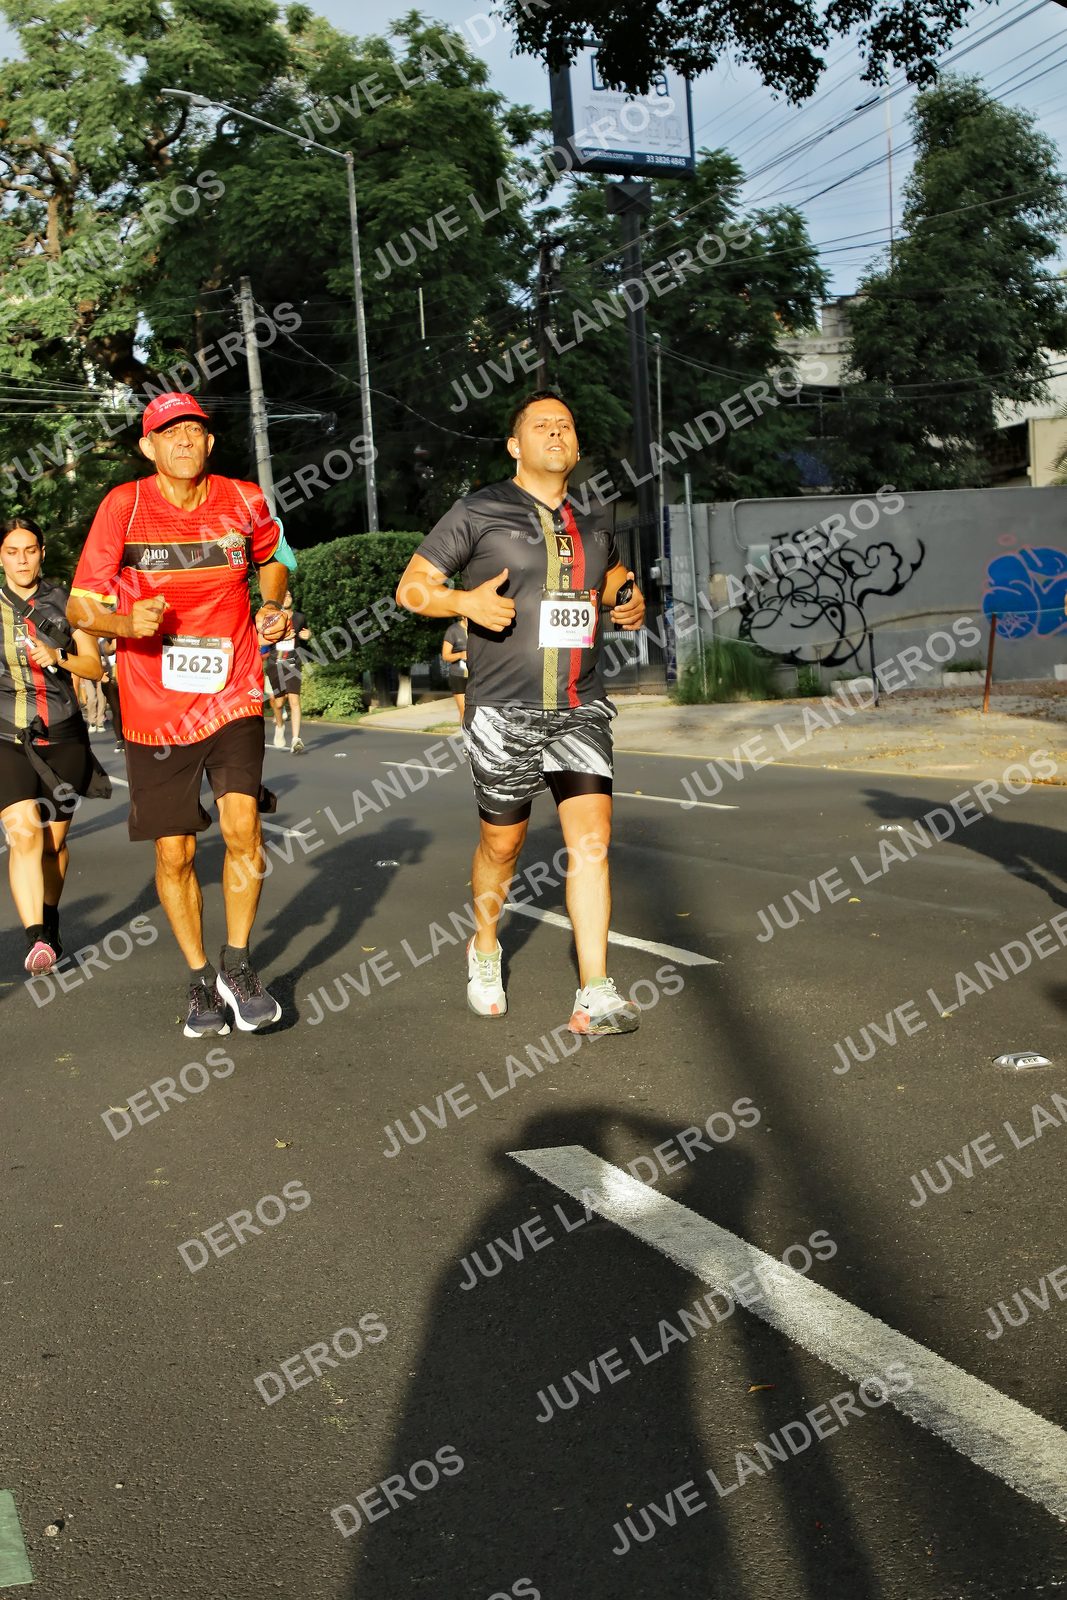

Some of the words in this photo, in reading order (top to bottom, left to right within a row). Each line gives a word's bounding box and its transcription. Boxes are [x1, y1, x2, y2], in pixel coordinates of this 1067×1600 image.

[150, 548, 168, 560] 100
[550, 608, 590, 627] 8839
[166, 653, 222, 674] 12623
